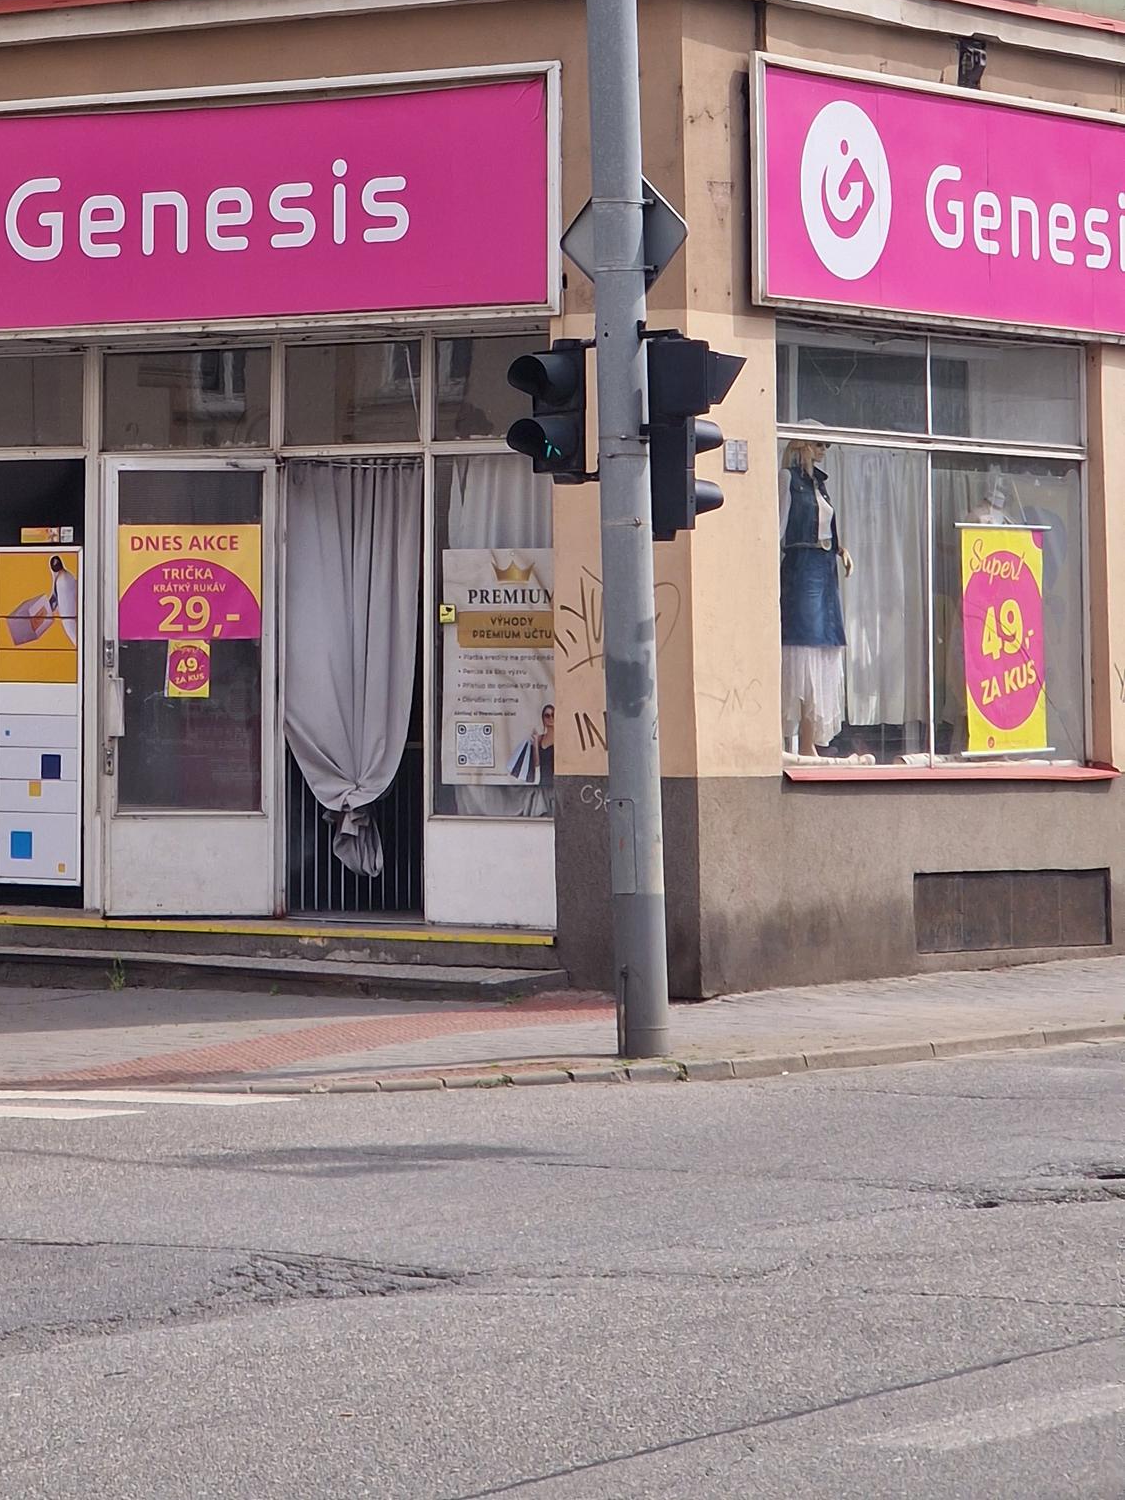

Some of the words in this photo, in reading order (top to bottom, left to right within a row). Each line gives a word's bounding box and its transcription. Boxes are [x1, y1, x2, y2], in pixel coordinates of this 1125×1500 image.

[5, 158, 410, 262] Genesis
[925, 164, 1125, 273] Genesi
[130, 535, 182, 551] DNES
[188, 535, 239, 551] AKCE
[970, 539, 1025, 585] Super!
[162, 565, 213, 580] TRIČKA
[153, 582, 190, 593] KRÁTKÝ
[193, 582, 226, 592] RUKÁV
[468, 589, 554, 604] PREMIUM
[158, 595, 240, 638] 29,-
[490, 614, 534, 626] VÝHODY
[472, 630, 521, 639] PREMIUM
[981, 675, 1002, 705] ZA
[1004, 660, 1037, 695] KUS
